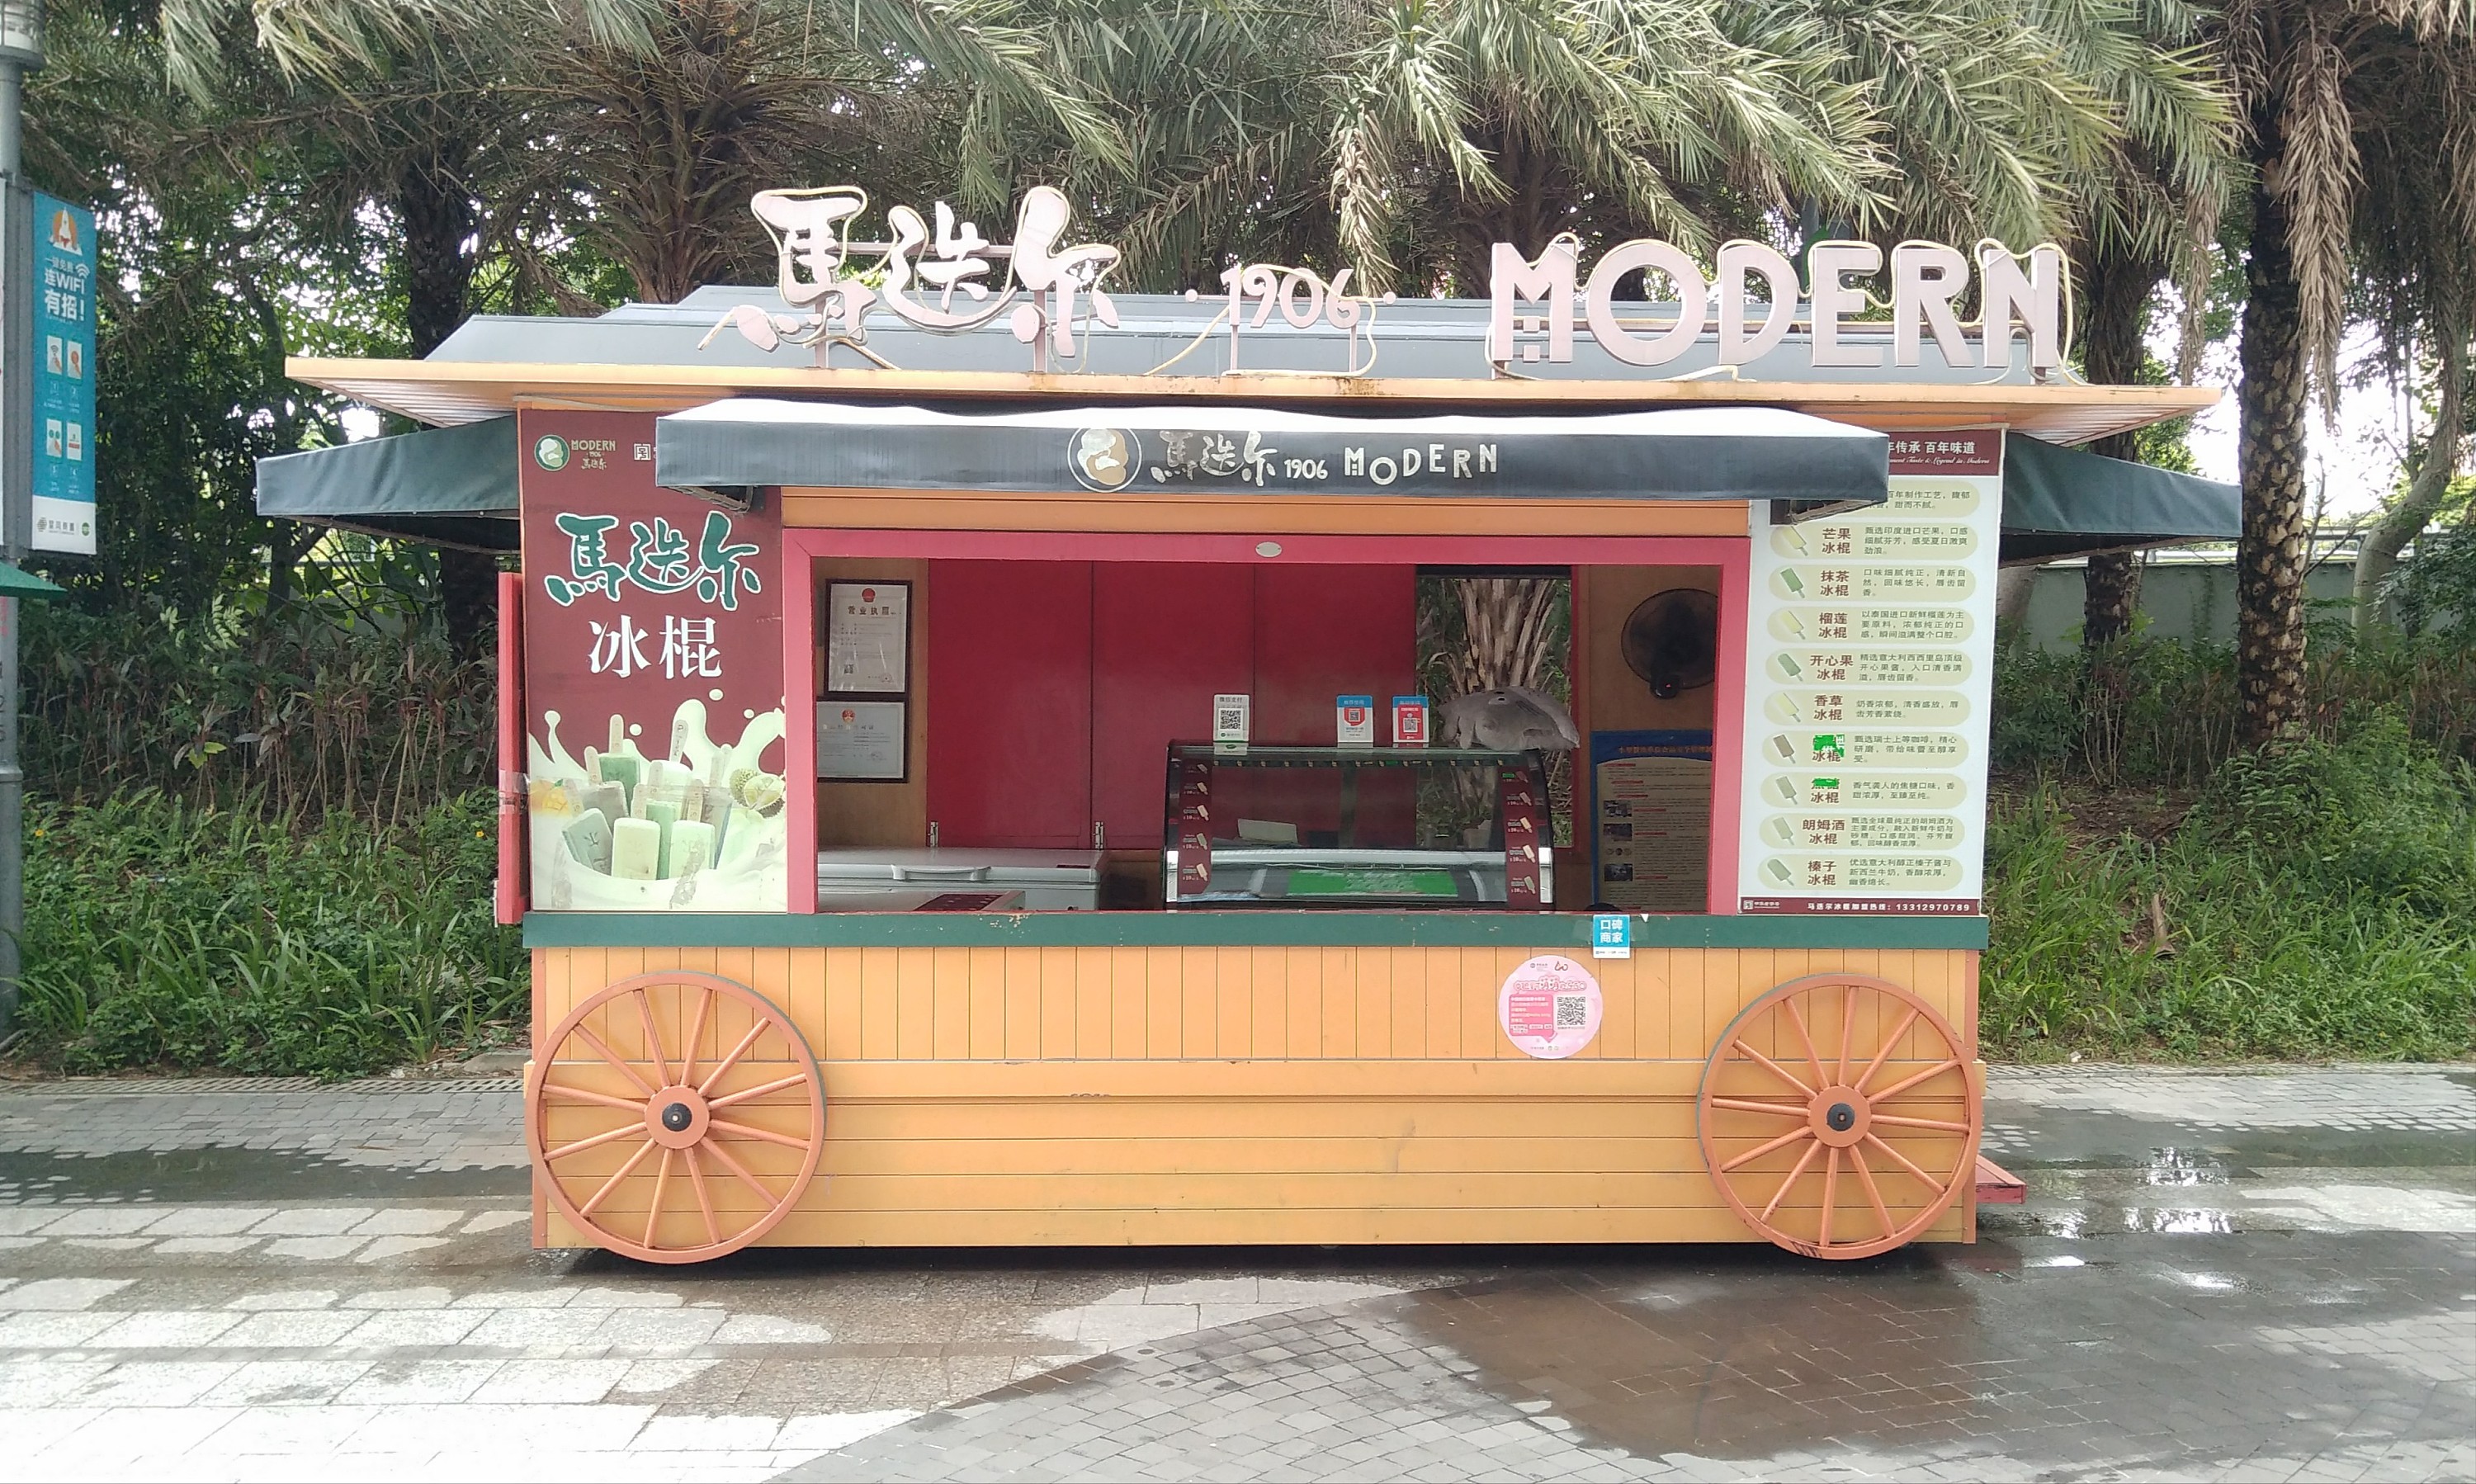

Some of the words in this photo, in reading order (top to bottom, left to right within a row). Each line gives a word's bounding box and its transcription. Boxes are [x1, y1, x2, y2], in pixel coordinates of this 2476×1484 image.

[1221, 267, 1361, 329] 1906
[1491, 243, 2059, 368] MODERN
[571, 439, 617, 451] MODERN
[1924, 441, 1976, 455] 百年味道
[1283, 458, 1329, 480] 1906
[1344, 443, 1498, 486] MODERN
[1822, 527, 1851, 540] 芒果
[1822, 542, 1851, 555] 冰棍
[1821, 570, 1850, 583] 抹茶
[1820, 584, 1850, 597] 冰棍
[1818, 612, 1848, 625] 榴莲
[1818, 626, 1848, 639] 冰棍
[588, 615, 723, 679] 冰棍
[1810, 655, 1854, 666] 开心果
[1817, 669, 1845, 681] 冰棍
[1814, 695, 1843, 707] 香草
[1813, 709, 1843, 721] 冰棍
[1810, 792, 1840, 804] 冰棍
[1802, 819, 1845, 831] 朗姆酒
[1809, 833, 1838, 845] 冰棍
[1807, 860, 1837, 872] 榛子
[1807, 873, 1836, 886] 冰棍
[1896, 902, 1970, 912] 13312970789
[1599, 932, 1623, 943] 商家
